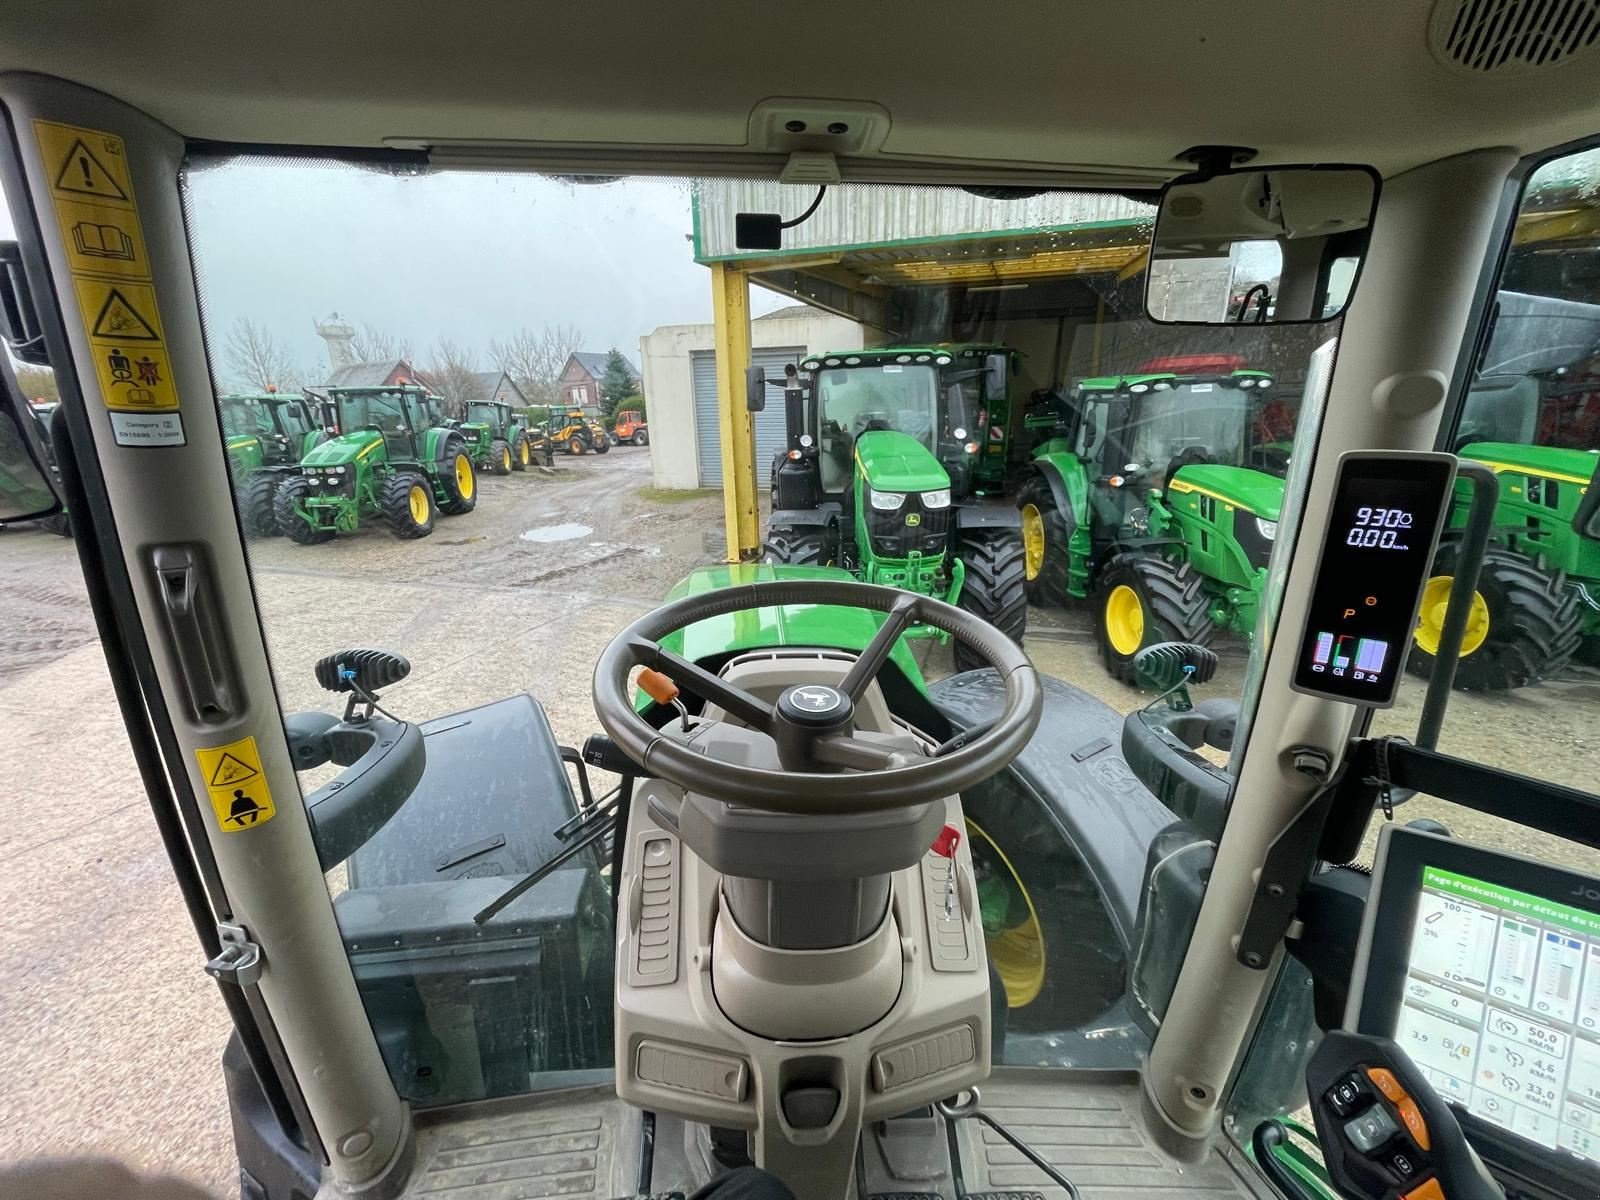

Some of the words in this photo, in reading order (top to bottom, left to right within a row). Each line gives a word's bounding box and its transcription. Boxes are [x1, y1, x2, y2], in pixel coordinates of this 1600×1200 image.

[125, 421, 159, 429] Category
[1355, 507, 1402, 528] 930
[1343, 608, 1356, 619] P
[1427, 872, 1452, 886] Page
[1452, 879, 1510, 904] d'exécution
[1512, 897, 1531, 911] par
[1532, 902, 1570, 922] défaut
[1571, 914, 1588, 927] du
[1443, 902, 1462, 913] 100
[1423, 927, 1439, 939] 3%
[1451, 998, 1459, 1008] 0
[1411, 1029, 1429, 1042] 3.9
[1528, 1026, 1558, 1044] 50.0
[1533, 1059, 1555, 1074] 4.6
[1526, 1082, 1556, 1101] 33.0
